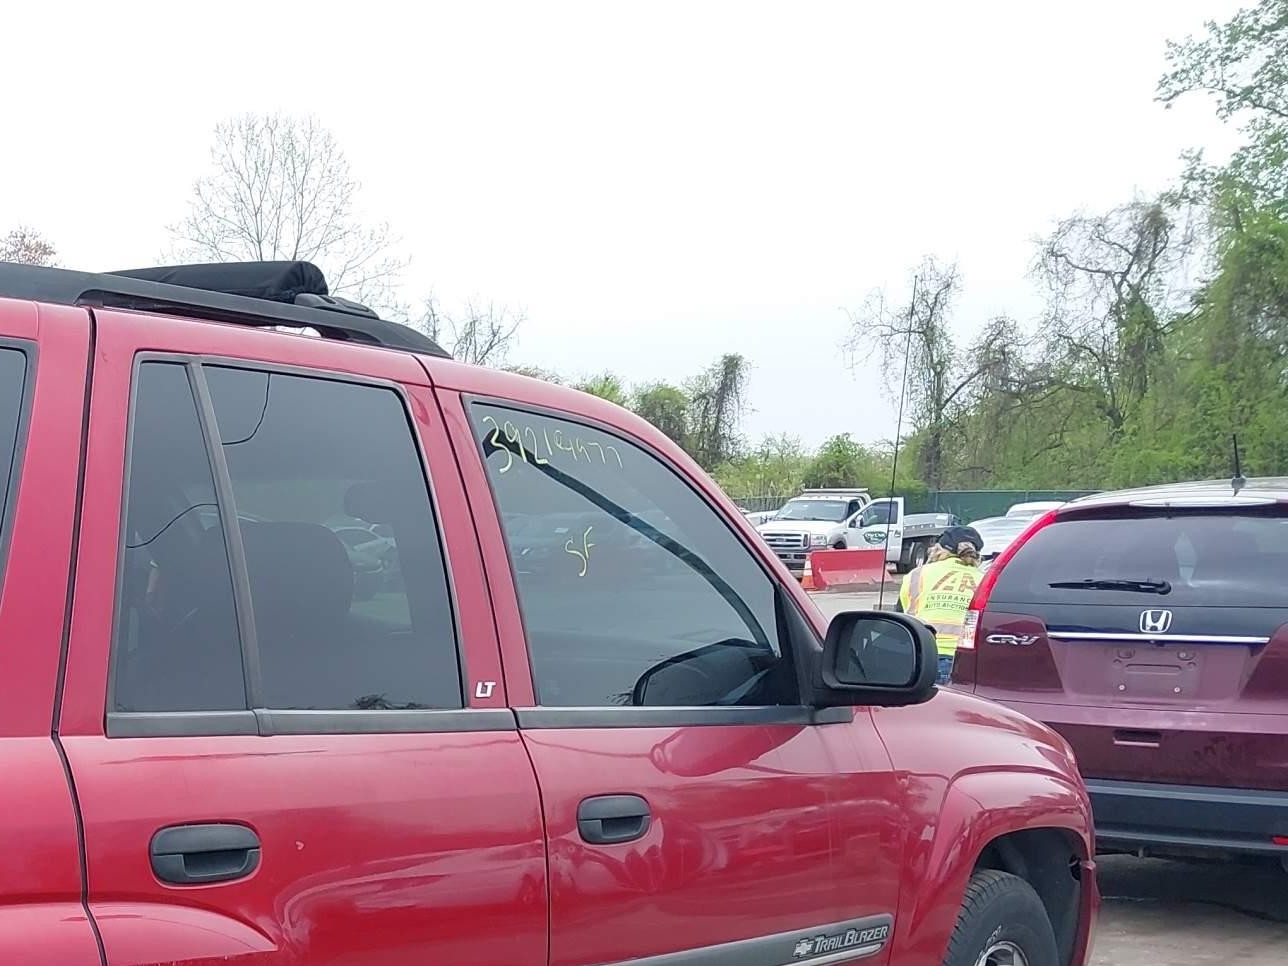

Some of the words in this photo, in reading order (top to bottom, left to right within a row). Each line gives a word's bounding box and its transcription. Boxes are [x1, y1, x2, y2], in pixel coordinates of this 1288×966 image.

[926, 593, 972, 604] INSURANC
[475, 681, 497, 698] LT
[814, 924, 889, 953] TRAILBLAZER
